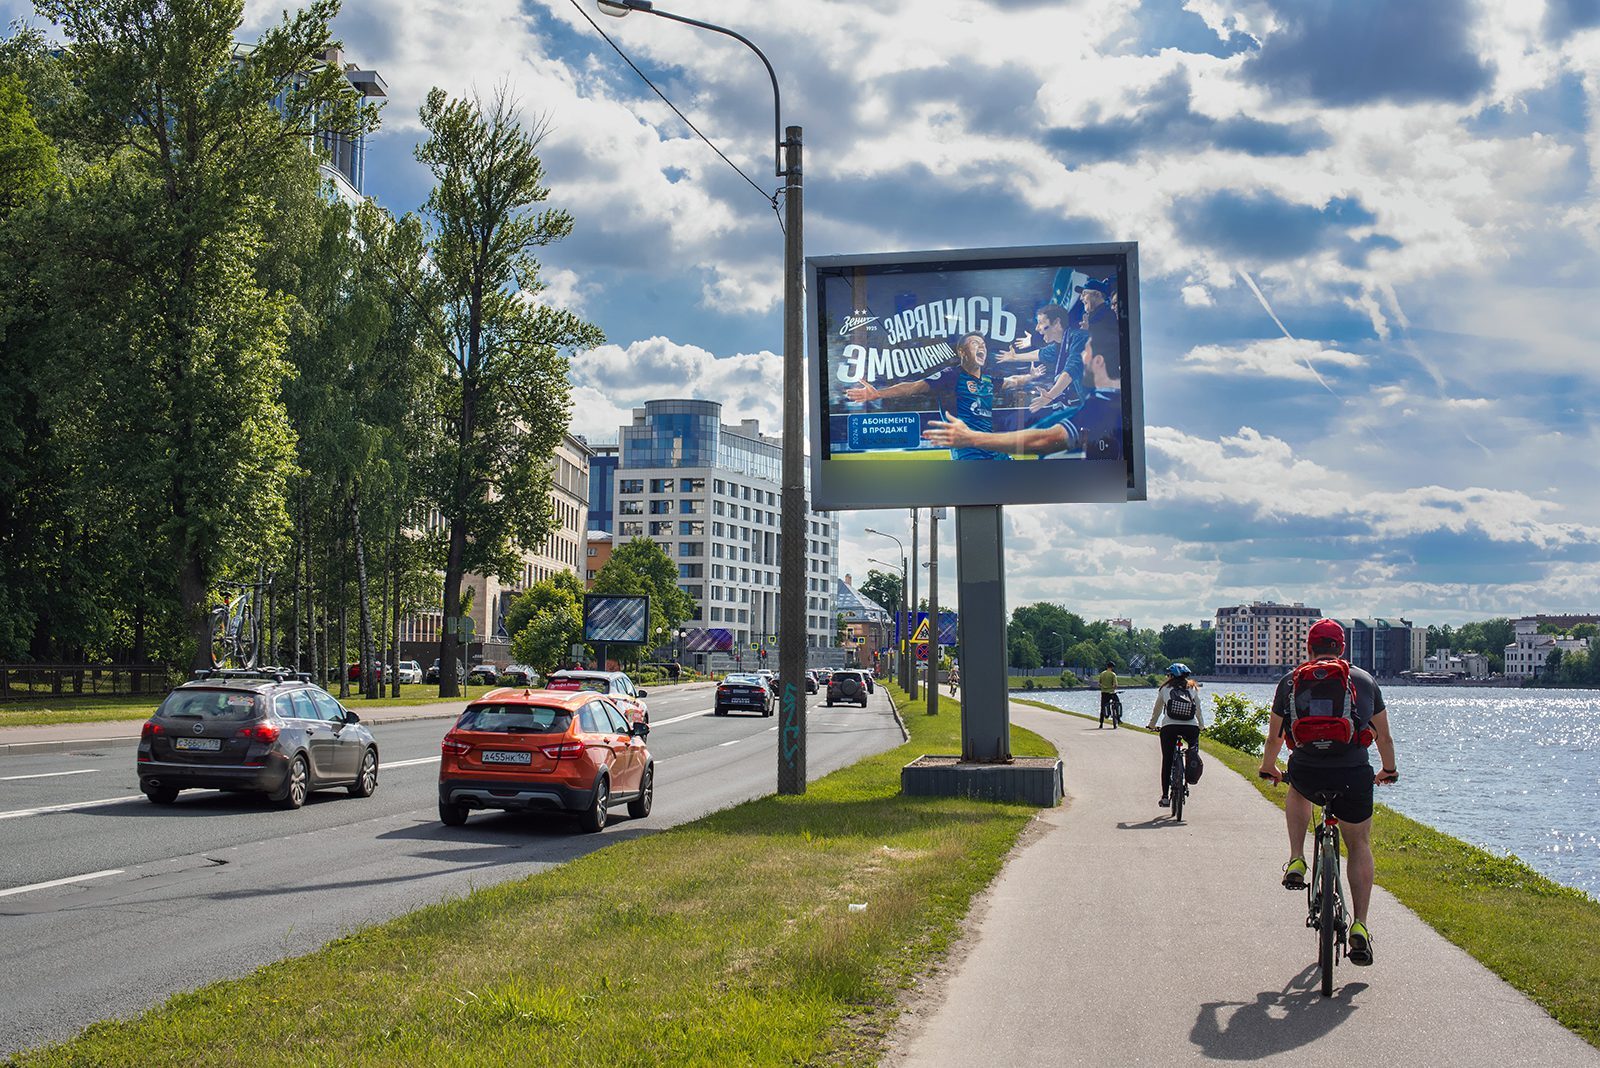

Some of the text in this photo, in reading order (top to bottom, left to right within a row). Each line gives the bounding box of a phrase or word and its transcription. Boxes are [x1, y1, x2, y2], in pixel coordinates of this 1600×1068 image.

[883, 295, 1017, 345] ЗАРЯДИСЬ
[836, 342, 957, 383] ЭМОЦИЯМИ!
[1099, 440, 1109, 451] 0+
